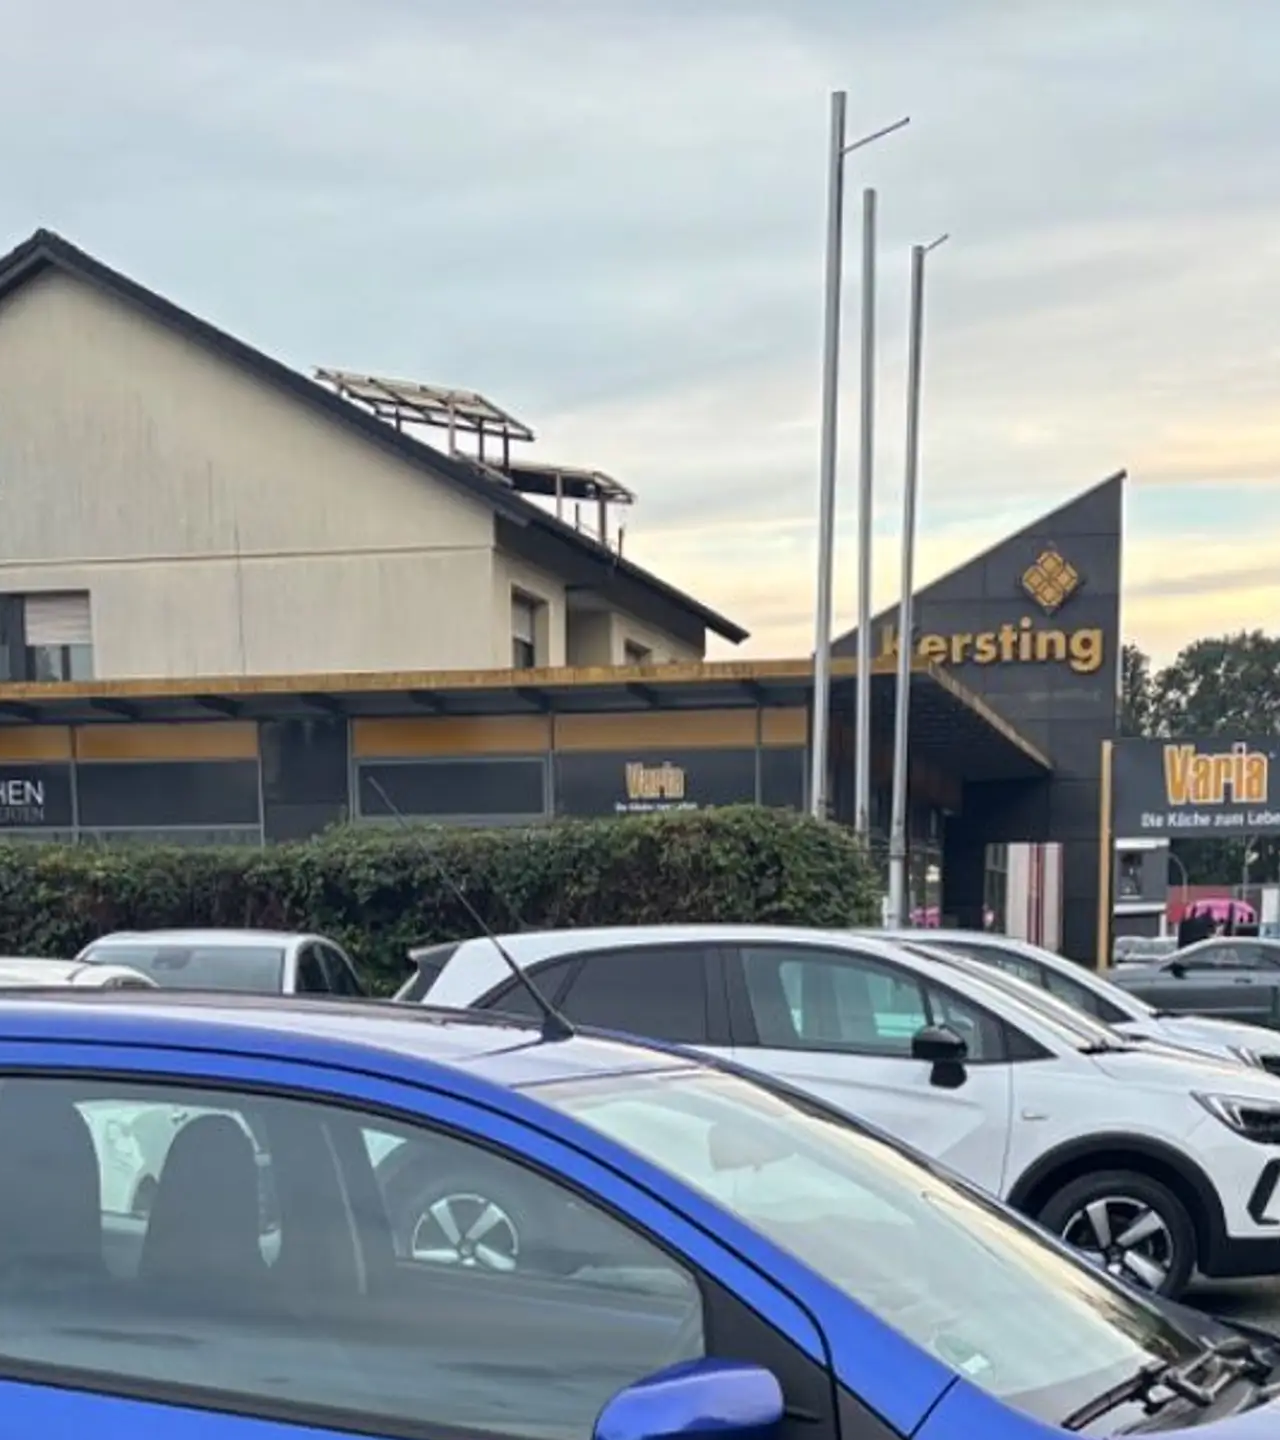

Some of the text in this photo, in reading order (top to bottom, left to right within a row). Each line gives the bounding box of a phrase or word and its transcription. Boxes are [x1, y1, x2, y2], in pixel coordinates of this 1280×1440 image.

[1163, 741, 1268, 805] Varia
[1140, 812, 1164, 827] Die
[1167, 811, 1211, 827] Küche
